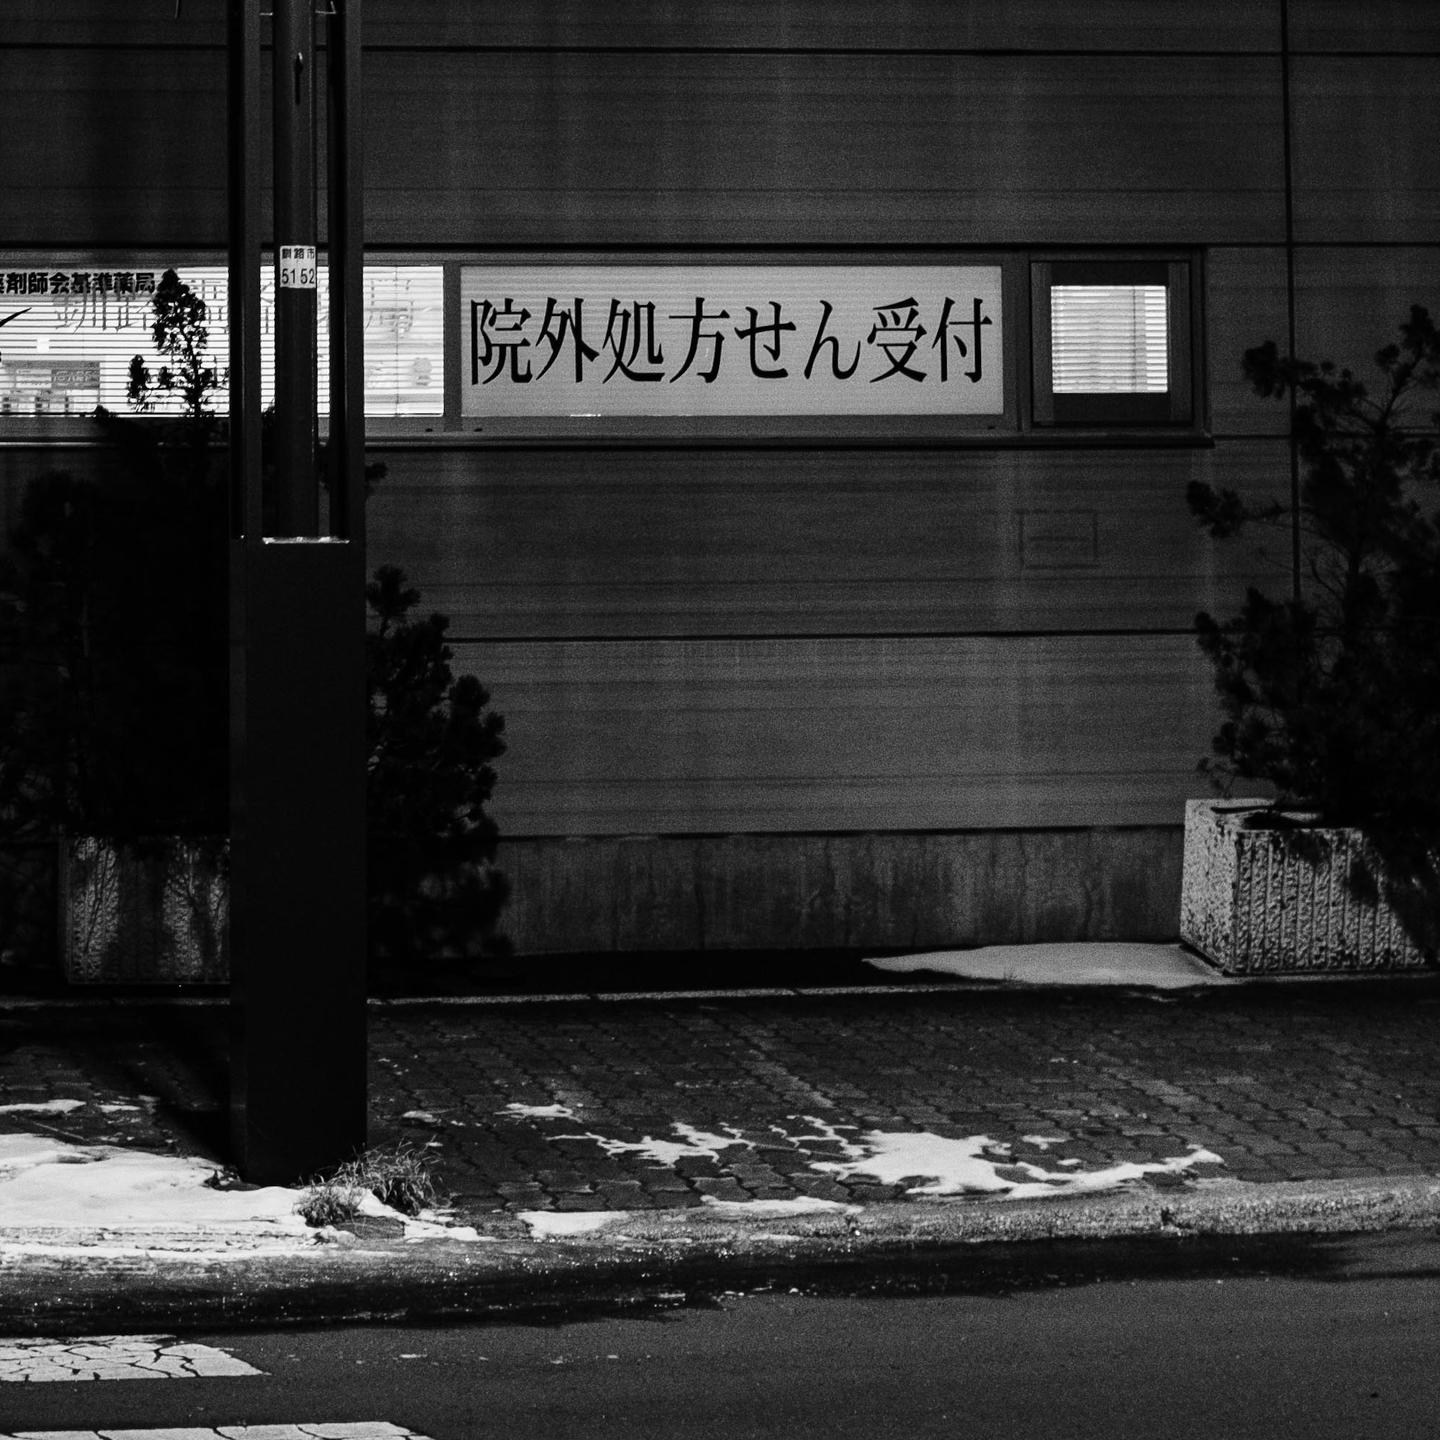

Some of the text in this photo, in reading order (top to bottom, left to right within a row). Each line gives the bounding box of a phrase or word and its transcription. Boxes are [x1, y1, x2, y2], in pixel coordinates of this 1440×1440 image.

[471, 297, 993, 385] 院外処方せん受付
